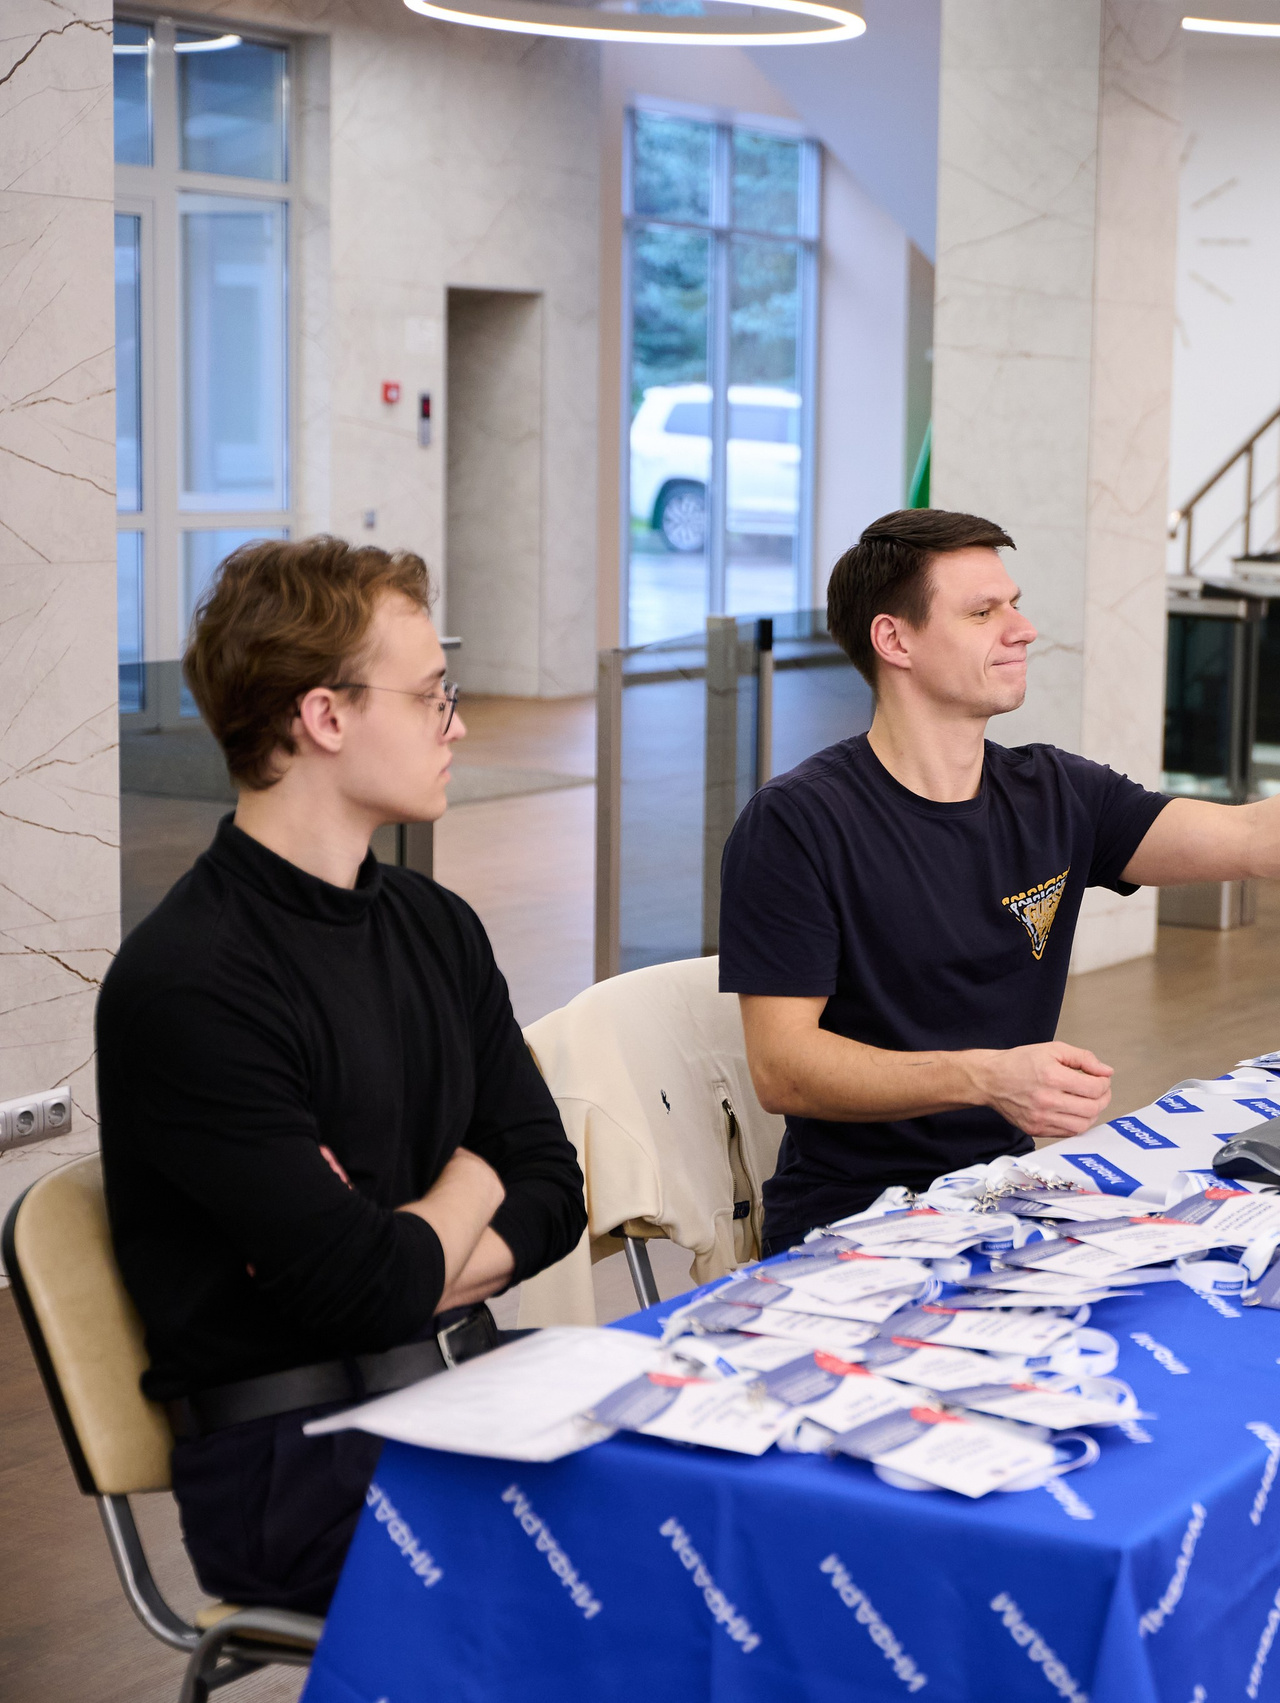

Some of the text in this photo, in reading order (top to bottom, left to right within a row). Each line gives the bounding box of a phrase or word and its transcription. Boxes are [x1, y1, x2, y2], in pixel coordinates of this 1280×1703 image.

[1078, 1156, 1126, 1185] ИНФАРМ
[1116, 1119, 1163, 1147] ИНФАРМ
[501, 1484, 602, 1620] ИНФАРМ
[658, 1516, 762, 1654] ИНФАРМ
[819, 1553, 928, 1692] ИНФАРМ
